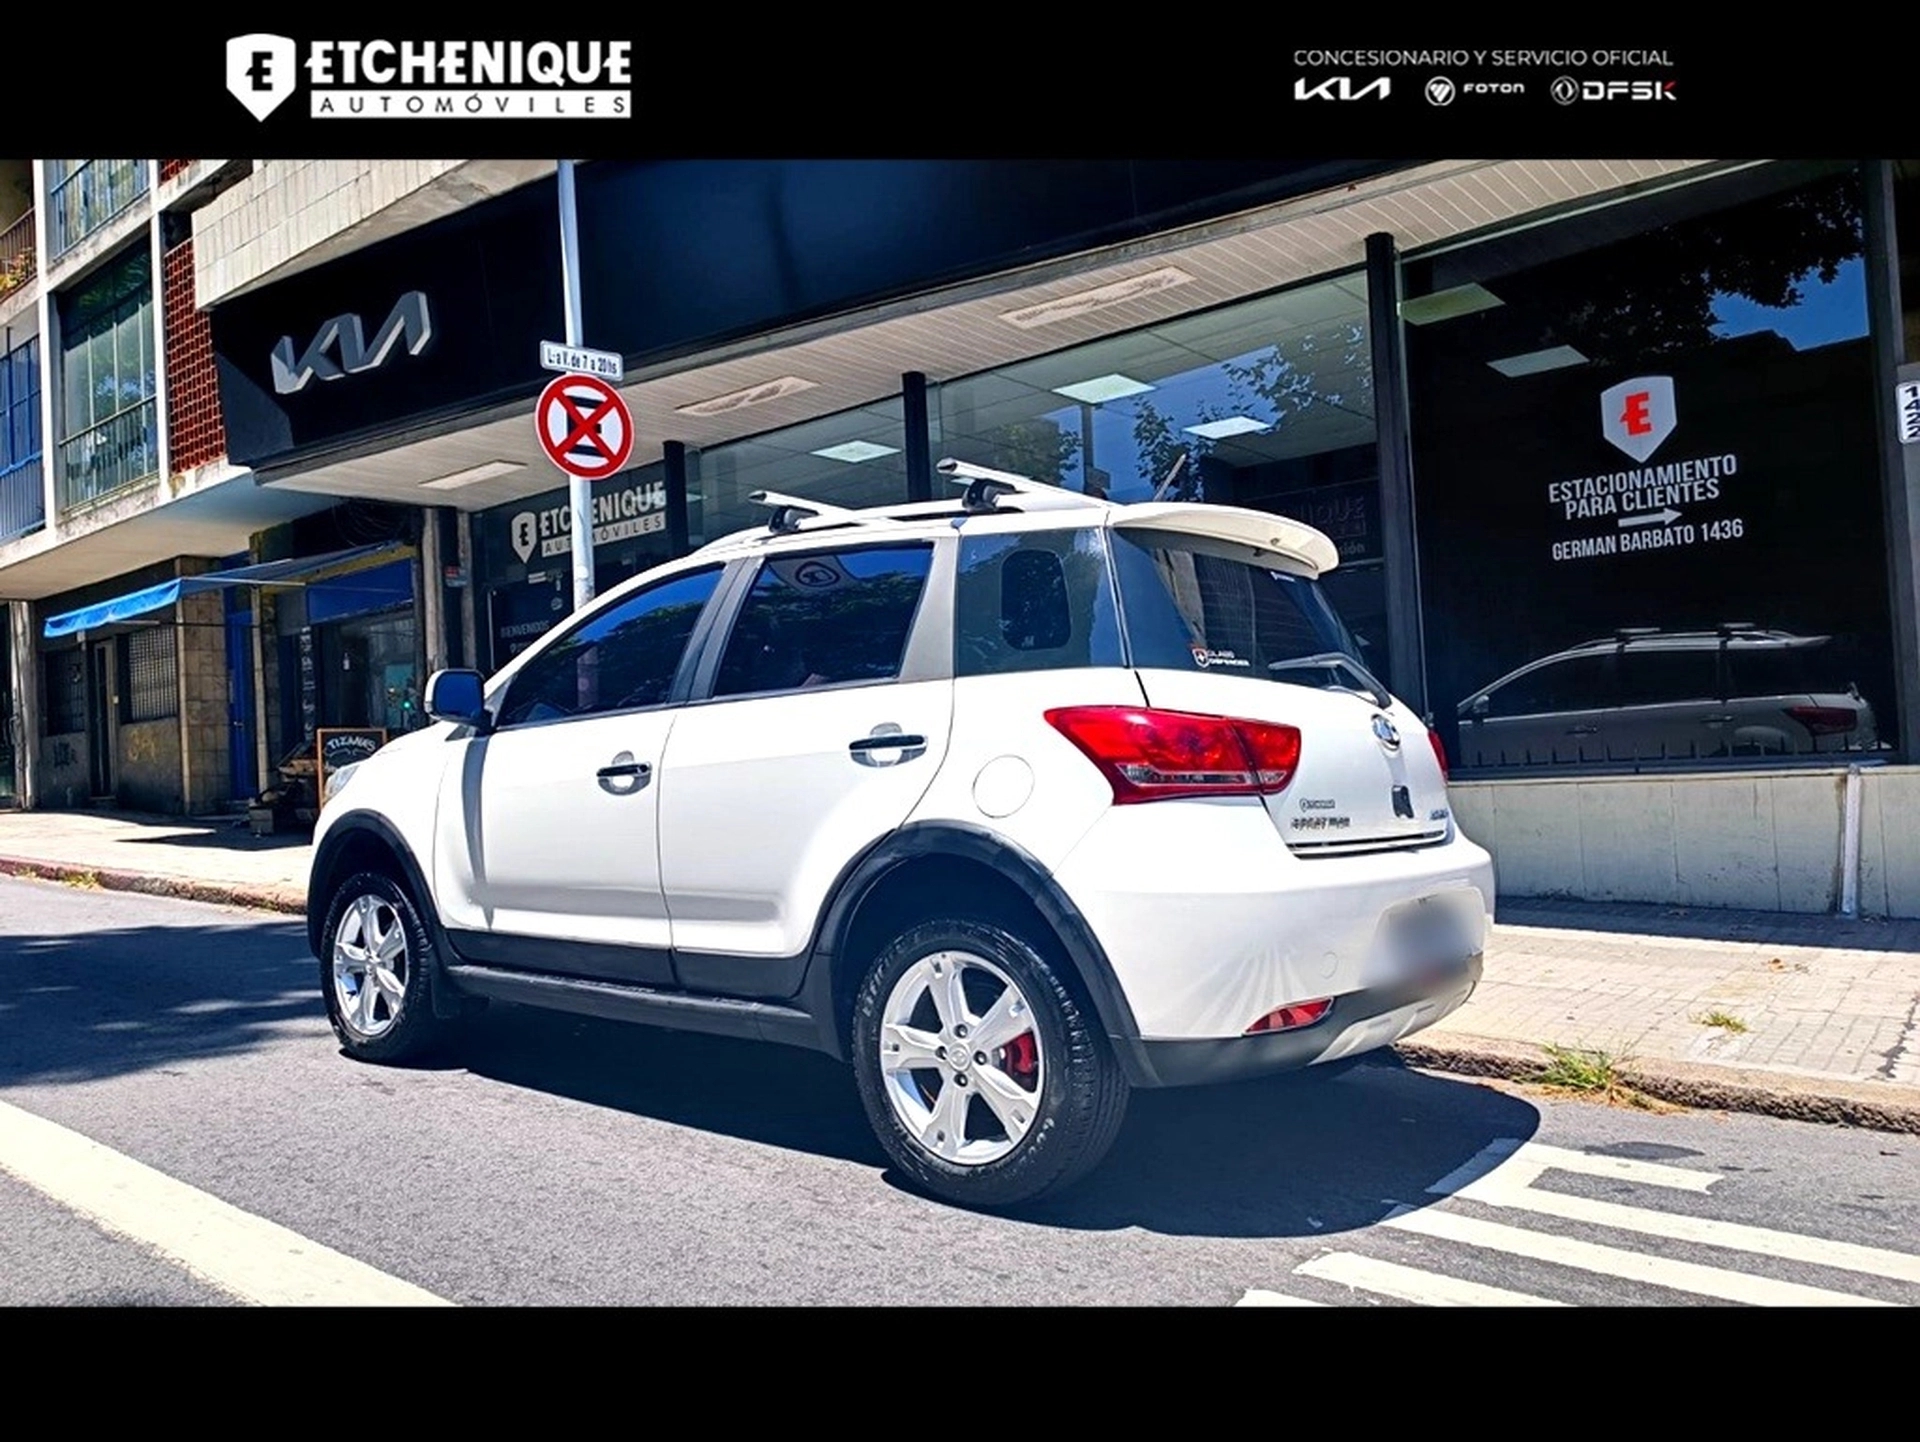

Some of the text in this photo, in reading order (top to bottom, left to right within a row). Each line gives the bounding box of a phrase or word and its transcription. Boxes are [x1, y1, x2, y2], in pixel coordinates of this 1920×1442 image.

[270, 290, 431, 394] KIA
[583, 354, 588, 369] 7
[1549, 454, 1738, 503] ESTACIONAMIENTO
[1565, 477, 1720, 521] PARA CLIENTES
[540, 481, 666, 537] ETCENIQUE
[1552, 518, 1744, 561] GERMAN BARBATO 1436
